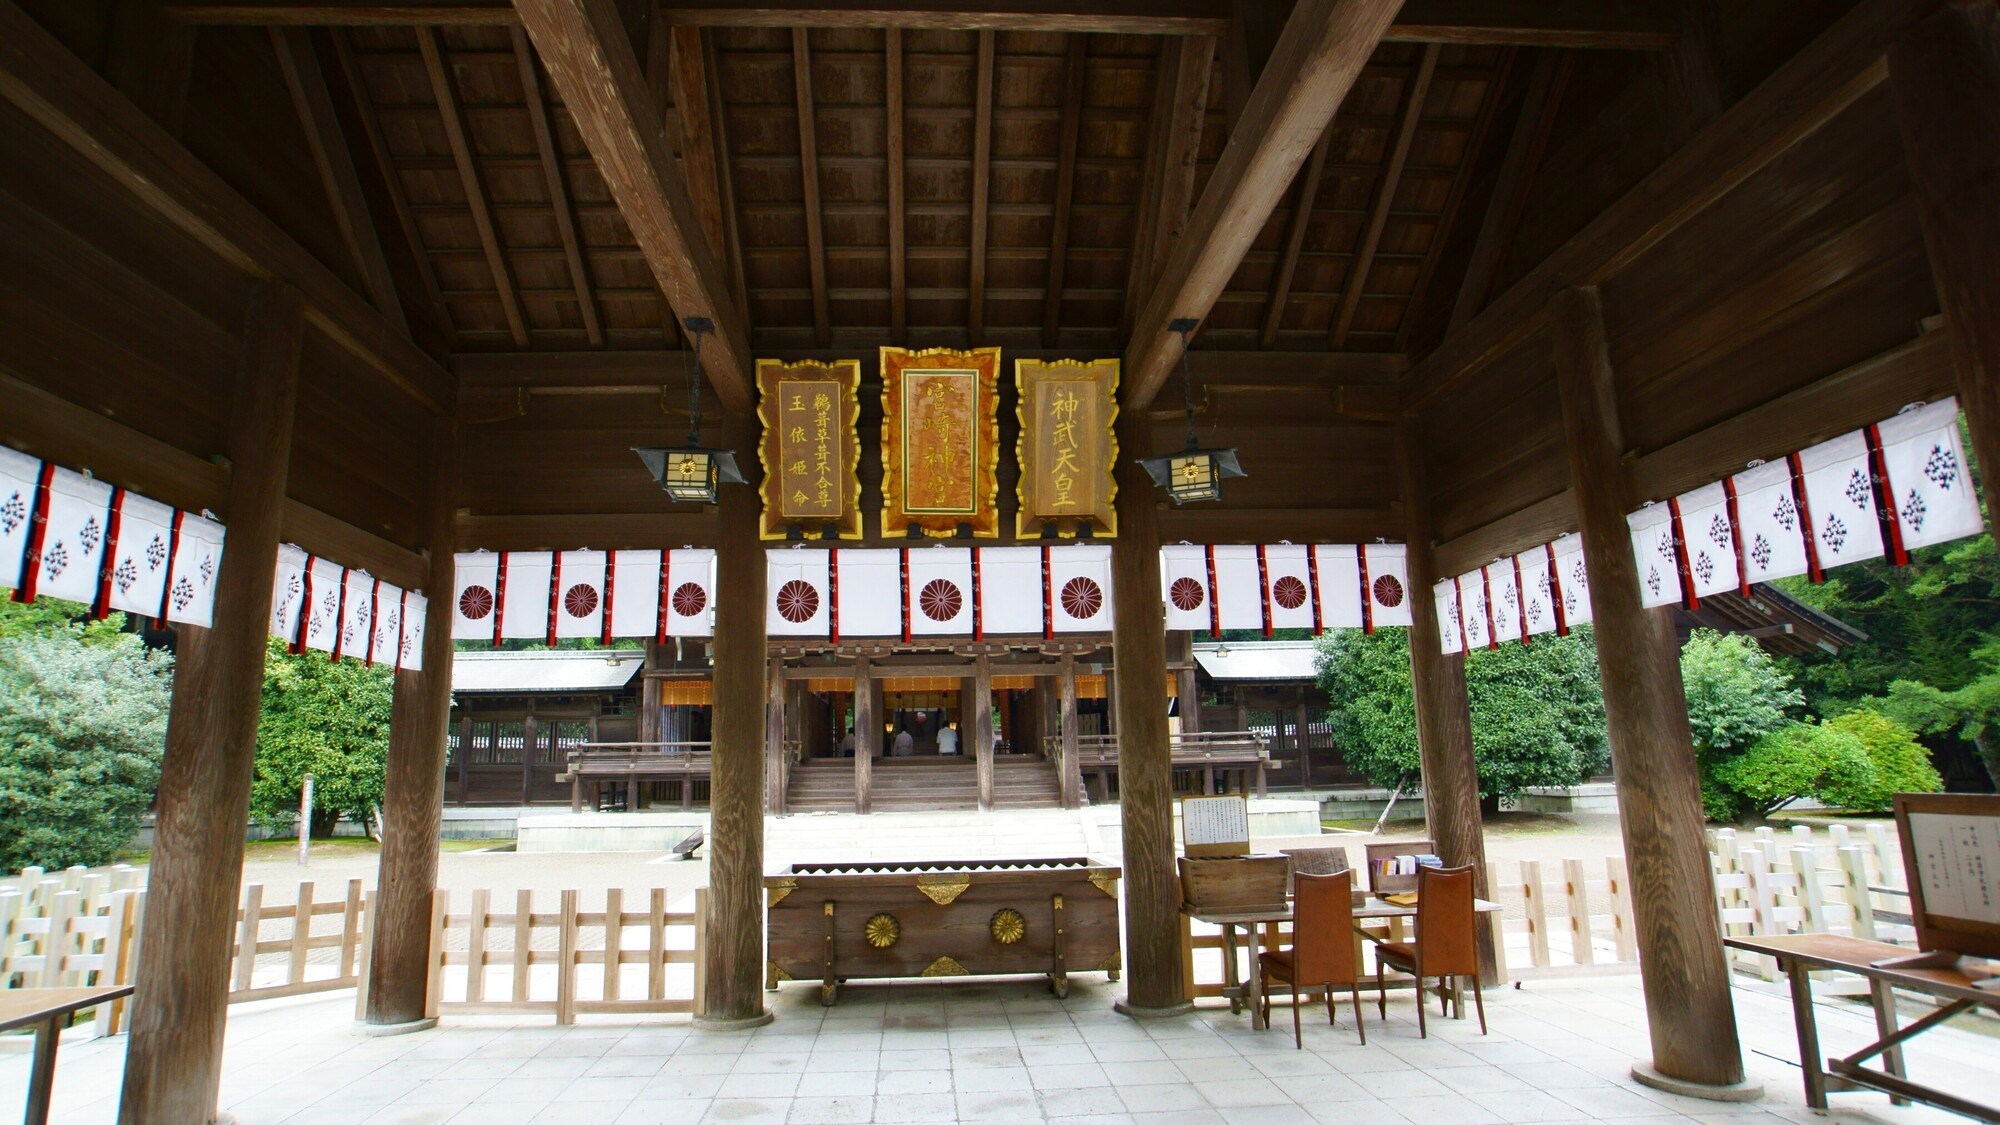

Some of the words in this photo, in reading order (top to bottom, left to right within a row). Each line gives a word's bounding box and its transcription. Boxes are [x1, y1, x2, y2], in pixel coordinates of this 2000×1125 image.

[788, 395, 810, 507] 玉依姫命
[1050, 391, 1080, 507] 神武天皇
